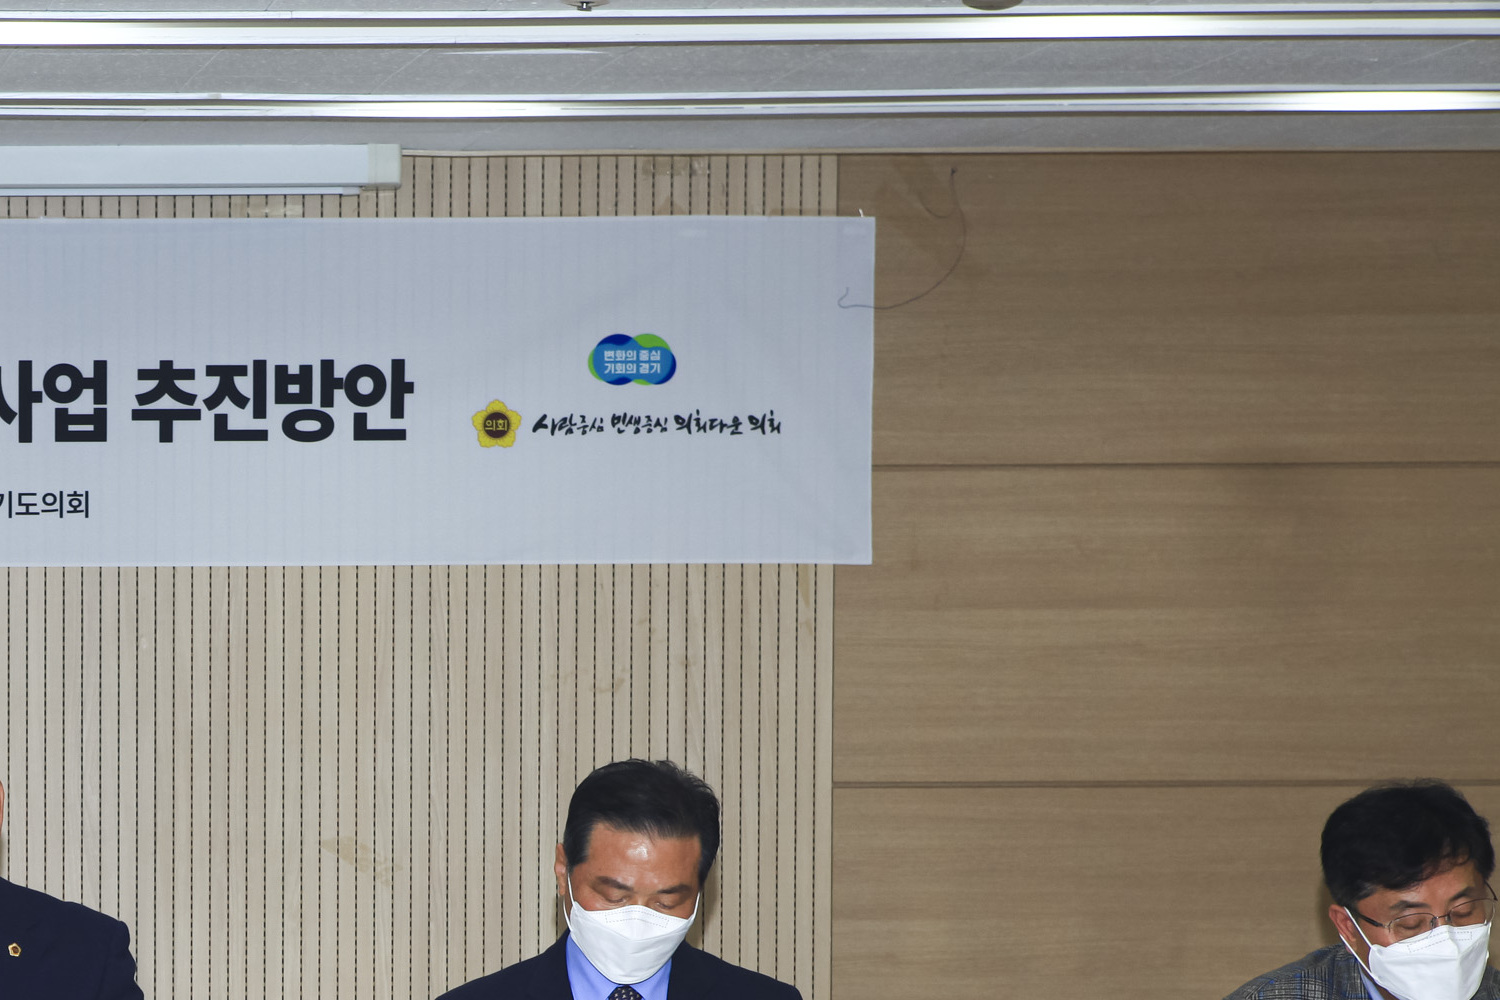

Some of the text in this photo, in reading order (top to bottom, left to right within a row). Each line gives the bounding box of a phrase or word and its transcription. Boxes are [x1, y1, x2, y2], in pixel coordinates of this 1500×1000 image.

[604, 350, 661, 361] 변화의 중심
[604, 363, 660, 373] 기회의 경기
[132, 359, 414, 443] 추진방안
[485, 419, 508, 432] 의회
[532, 409, 781, 436] 사람중심 민생중심 의회다운 의회
